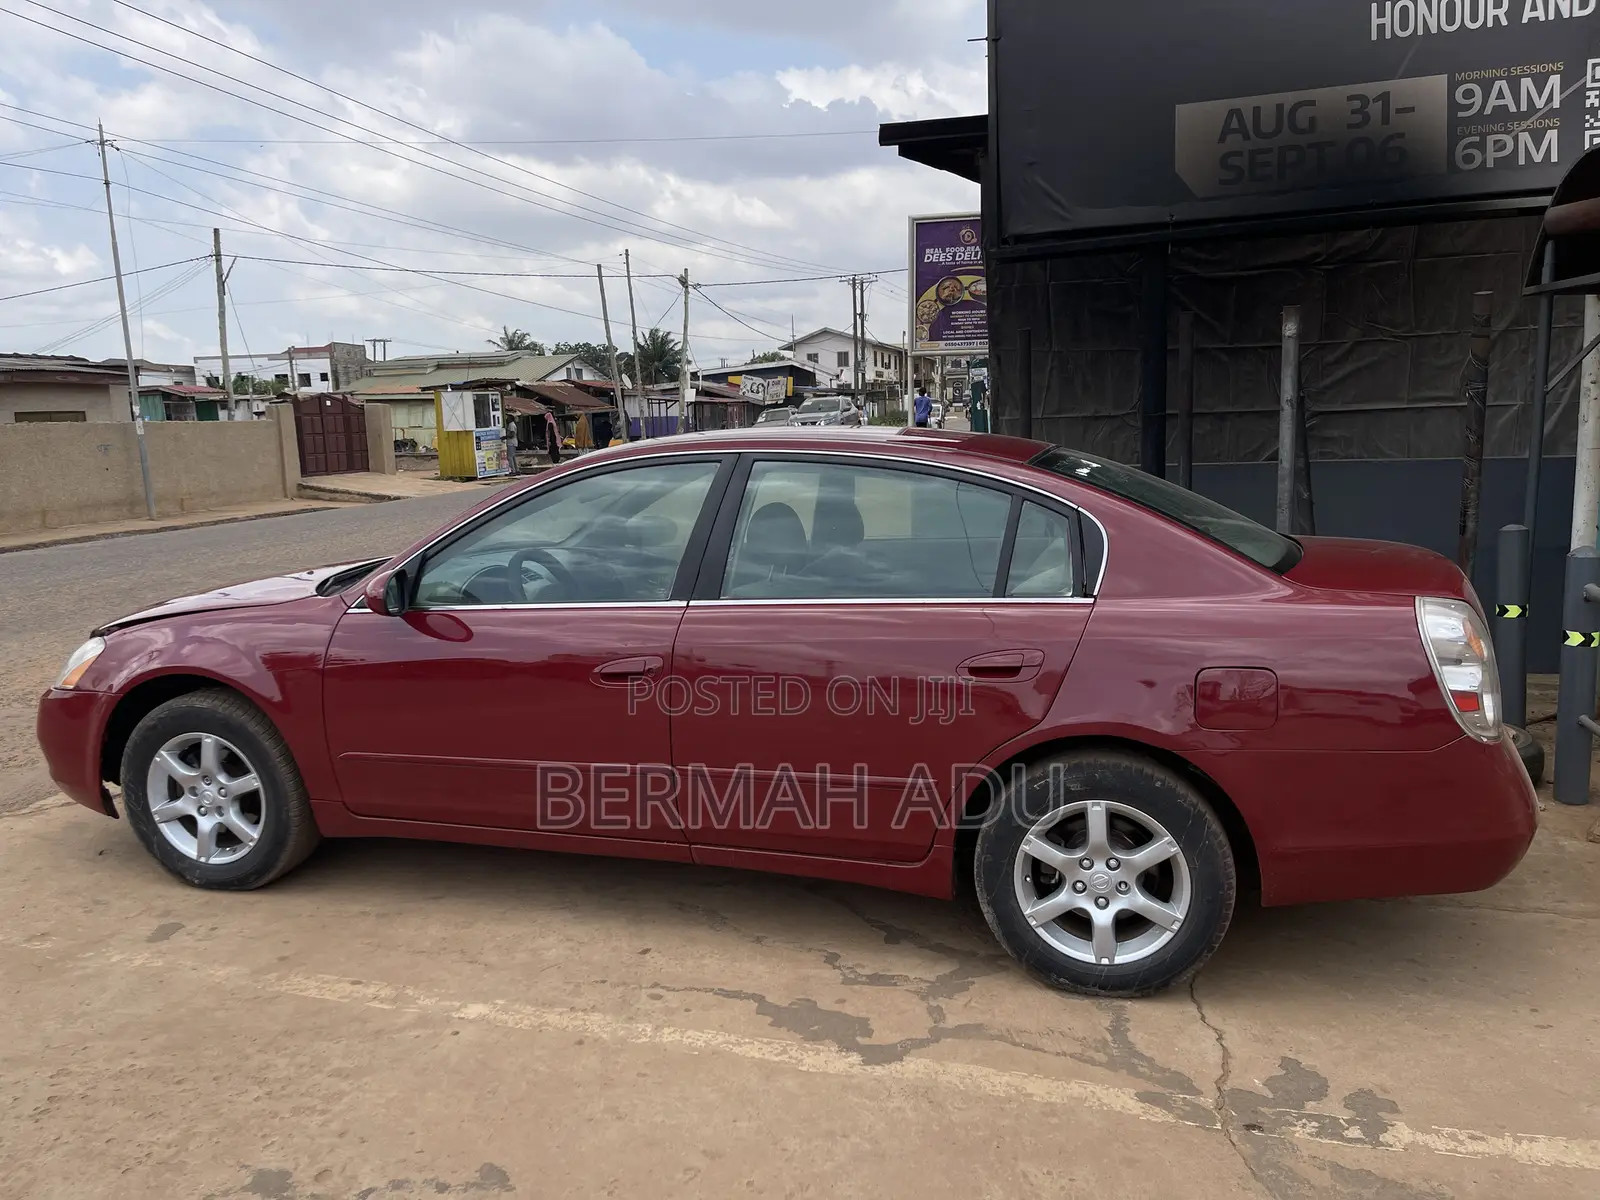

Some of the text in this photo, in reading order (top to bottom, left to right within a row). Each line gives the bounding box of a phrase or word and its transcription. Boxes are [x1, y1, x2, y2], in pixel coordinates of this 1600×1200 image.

[1371, 0, 1597, 40] HONOUR AND
[1455, 61, 1564, 81] MORNING SESSIONS
[1454, 74, 1561, 117] 9AM
[1217, 91, 1416, 144] AUG 31-
[1457, 117, 1561, 136] EVENING SESSIONS
[1218, 132, 1409, 186] SEPT 06
[1454, 129, 1559, 171] 6PM
[924, 252, 982, 262] DEES DELI
